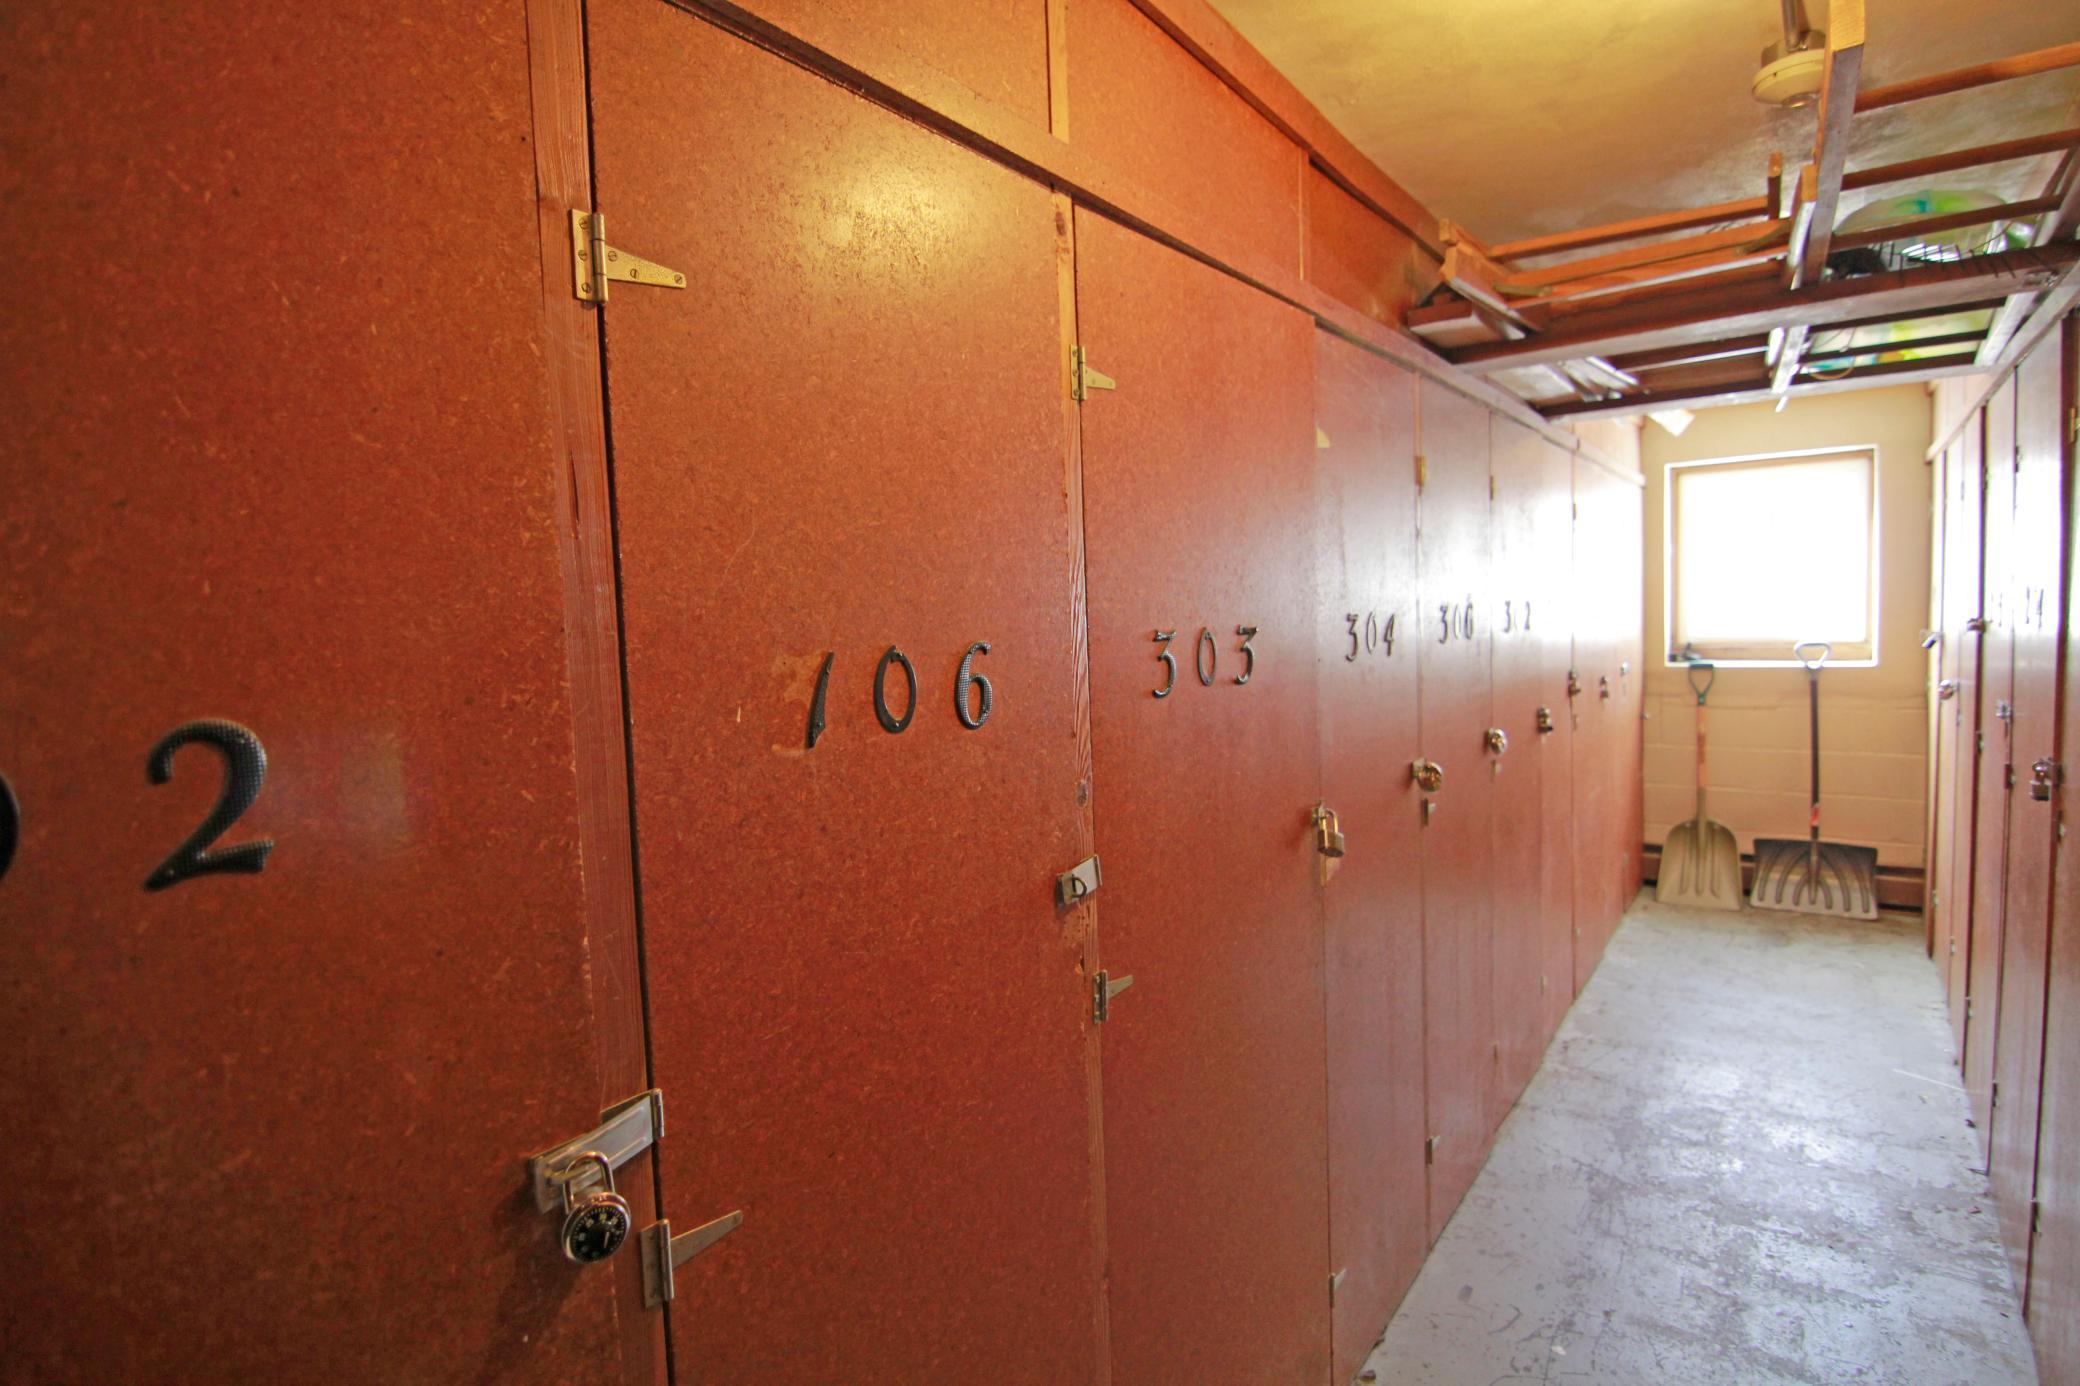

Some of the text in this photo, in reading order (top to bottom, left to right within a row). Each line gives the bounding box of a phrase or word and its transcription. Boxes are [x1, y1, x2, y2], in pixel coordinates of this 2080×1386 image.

[1346, 611, 1396, 662] 304
[1438, 600, 1474, 645] 306
[1152, 624, 1259, 699] 303
[805, 641, 993, 748] 106
